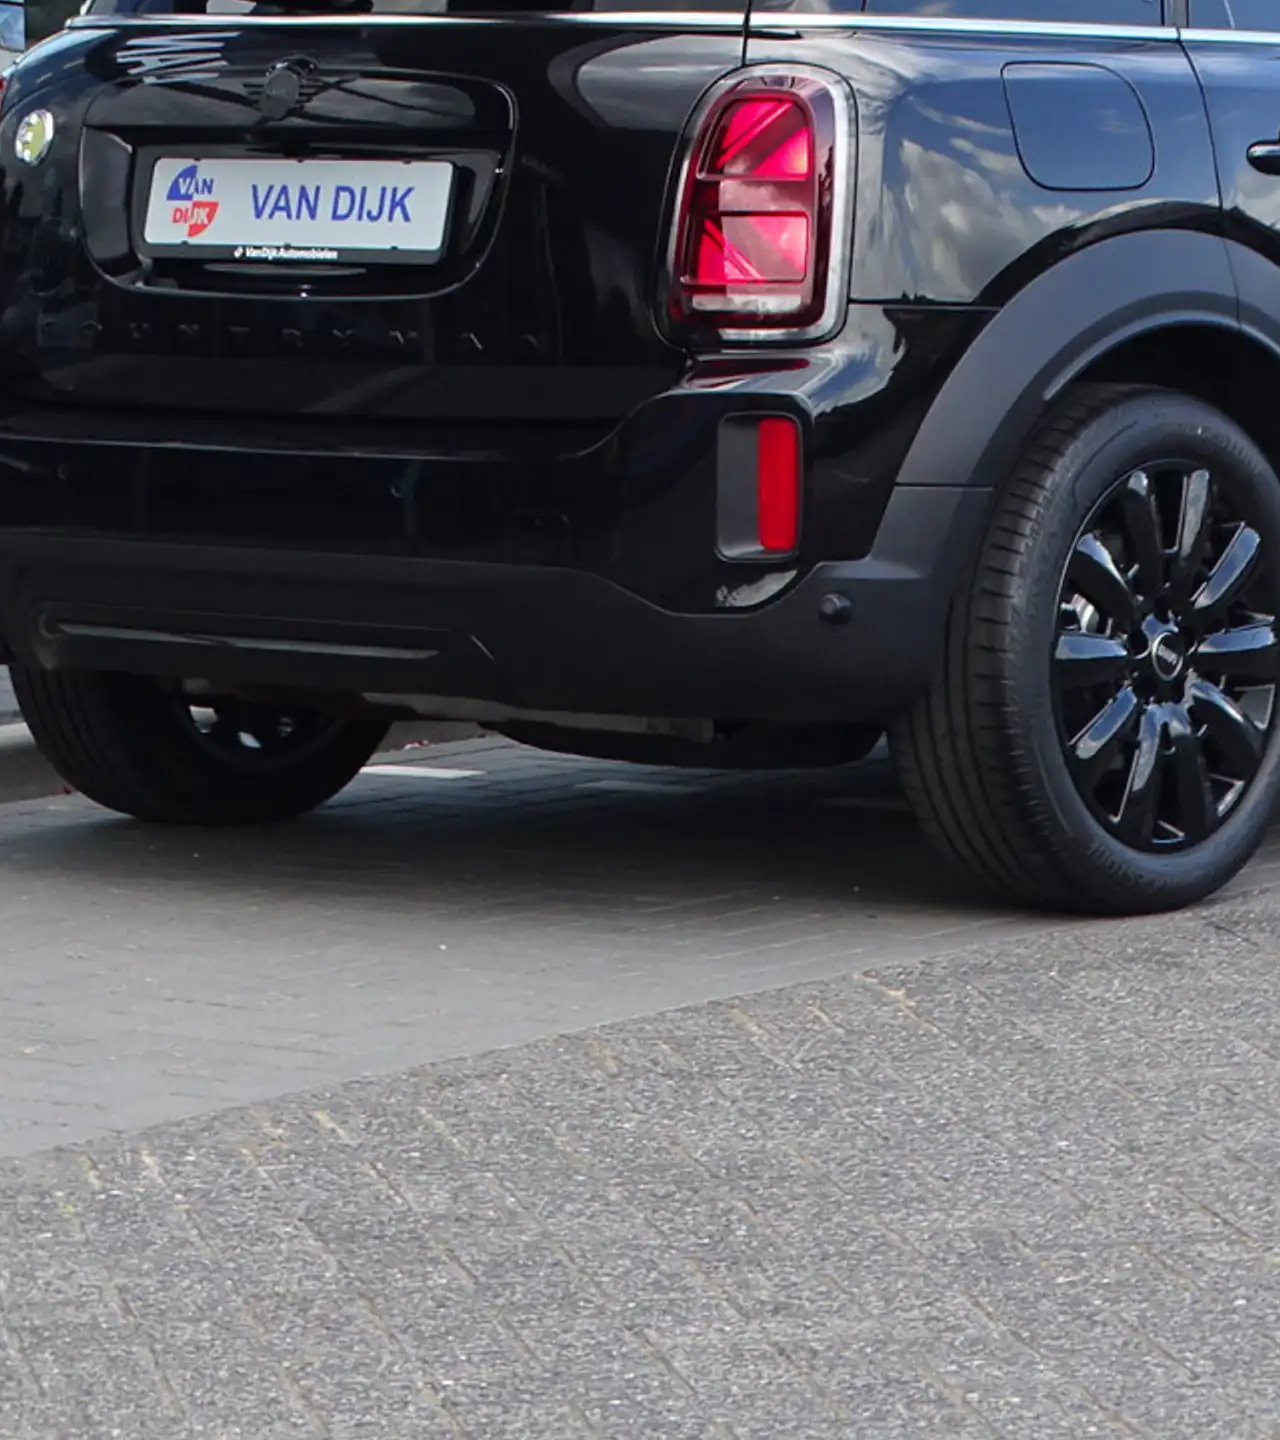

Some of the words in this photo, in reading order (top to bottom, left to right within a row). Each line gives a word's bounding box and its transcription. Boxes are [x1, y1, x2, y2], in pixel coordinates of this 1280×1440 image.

[178, 177, 214, 195] VAN
[251, 183, 321, 221] VAN
[331, 185, 415, 223] DIJK
[172, 207, 211, 225] DIJK
